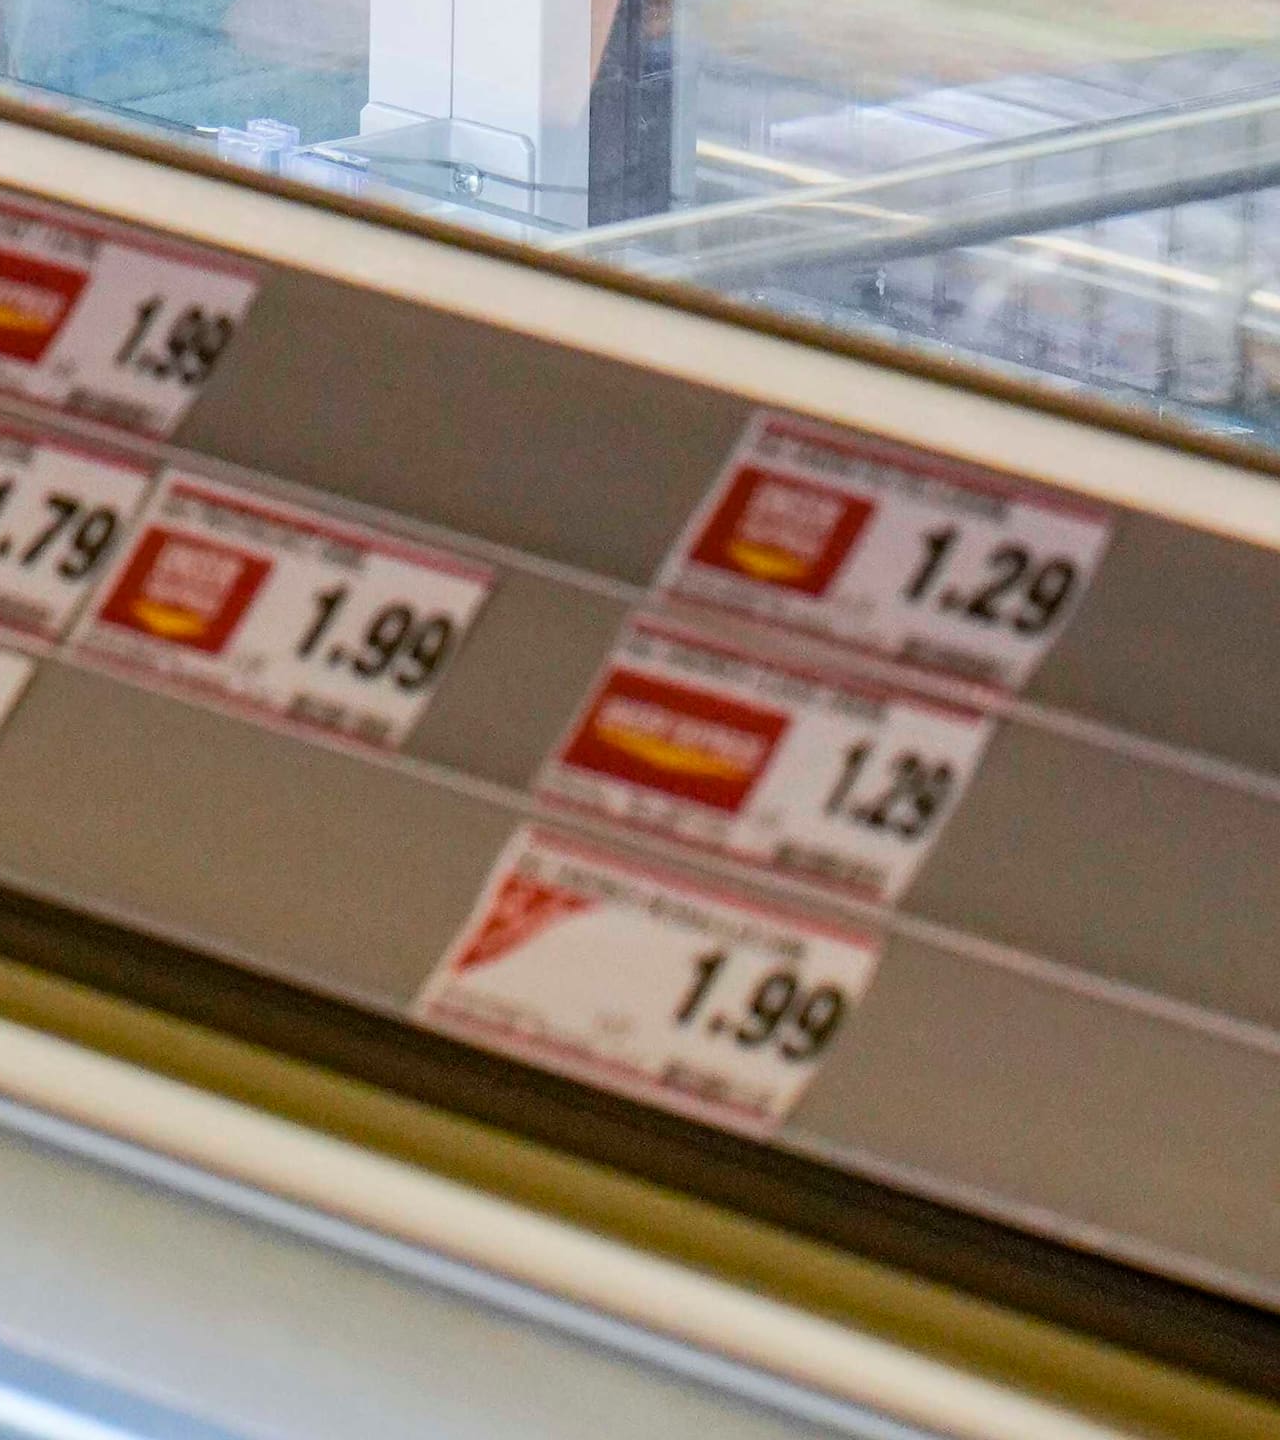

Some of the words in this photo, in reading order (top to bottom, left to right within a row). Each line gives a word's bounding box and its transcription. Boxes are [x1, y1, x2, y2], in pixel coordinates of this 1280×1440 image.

[902, 523, 1077, 636] 1.29
[297, 584, 457, 695] 1.99
[824, 737, 951, 840] 1.29
[674, 950, 846, 1065] 1.99
